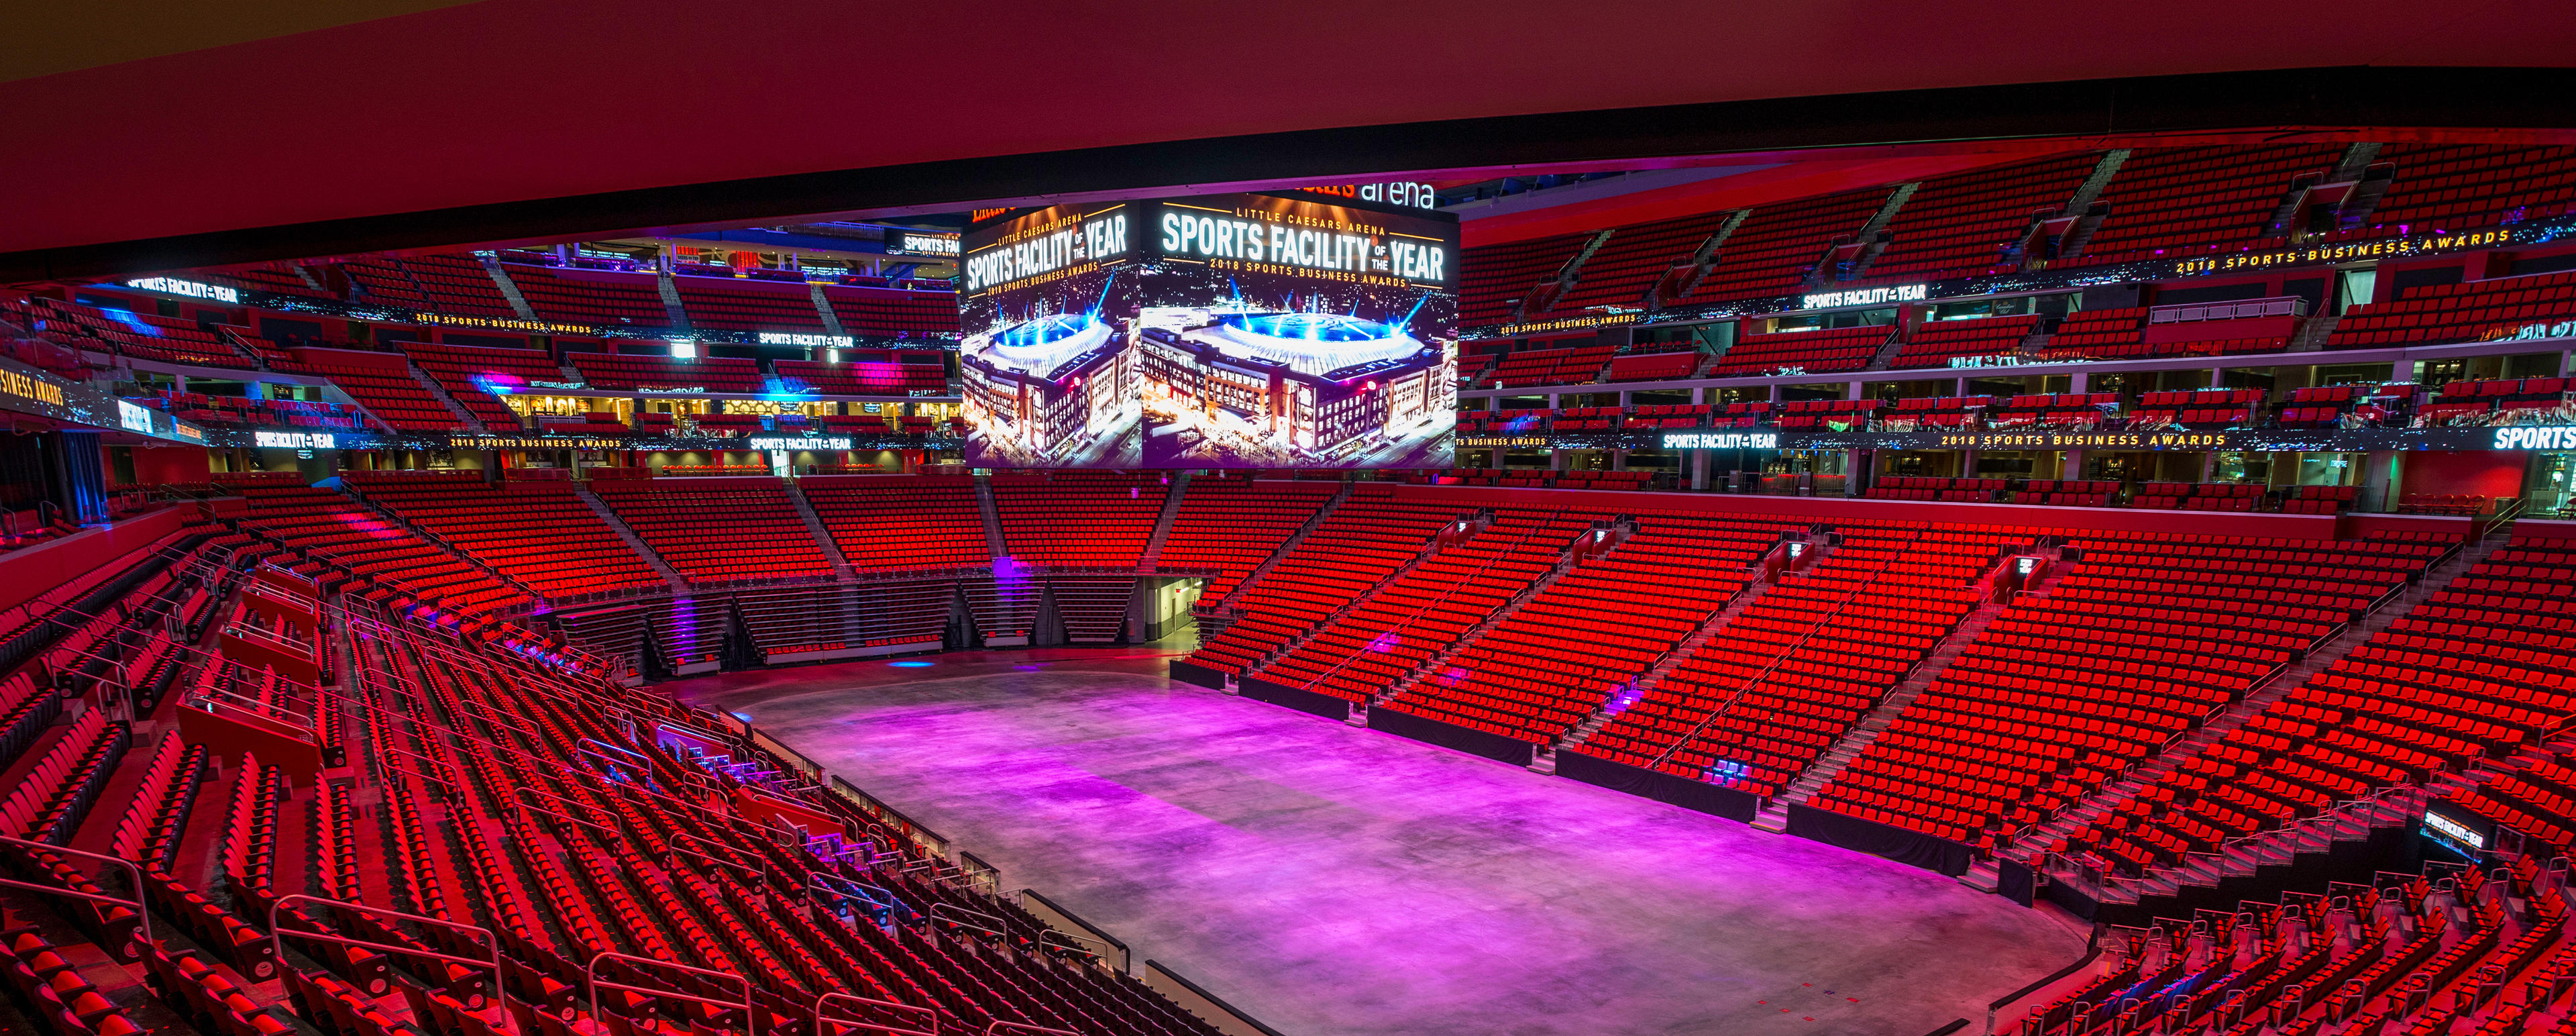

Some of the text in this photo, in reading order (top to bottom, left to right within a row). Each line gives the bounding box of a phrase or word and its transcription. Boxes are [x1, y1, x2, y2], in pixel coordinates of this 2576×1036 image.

[998, 213, 1081, 246] LITTLE CAESARS ARENA
[1237, 207, 1385, 236] LITTLE CAESARS ARENA
[905, 237, 943, 252] SPORTS
[967, 215, 1126, 291] SPORTS FACILITY OF THE YEAR
[1163, 213, 1443, 280] SPORTS FACILITY OF THE YEAR
[2177, 229, 2509, 272] 2018 SPORTS BUSINESS AWARDS
[988, 262, 1097, 297] 2018 SPORTS BUSINESS AWARDS
[1211, 258, 1405, 287] 2018 SPORTS BUSINESS AWARDS
[213, 285, 237, 303] YEAR
[1803, 292, 1842, 309] SPORTS
[1843, 288, 1889, 305] FACILITY
[1898, 284, 1926, 301] YEAR
[417, 313, 591, 333] 2018 SPORTS BUSINESS AWARDS
[1501, 315, 1635, 334] 2018 SPORTS BUSINESS AWARDS
[759, 333, 792, 344] SPORTS
[792, 334, 826, 346] FACILITY
[832, 336, 853, 348] YEAR
[35, 380, 64, 407] AWARDS
[521, 439, 573, 447] BUSINESS
[579, 439, 621, 447] AWARDS
[751, 438, 785, 450] SPORTS
[786, 438, 822, 450] FACILITY
[828, 438, 851, 450] YEAR
[1664, 434, 1699, 448] SPORTS
[1701, 434, 1742, 448] FACILITY
[1750, 434, 1776, 448] YEAR
[1942, 435, 2226, 445] 2018 SPORTS BUSINESS AWARDS
[2494, 427, 2576, 449] SPORTS
